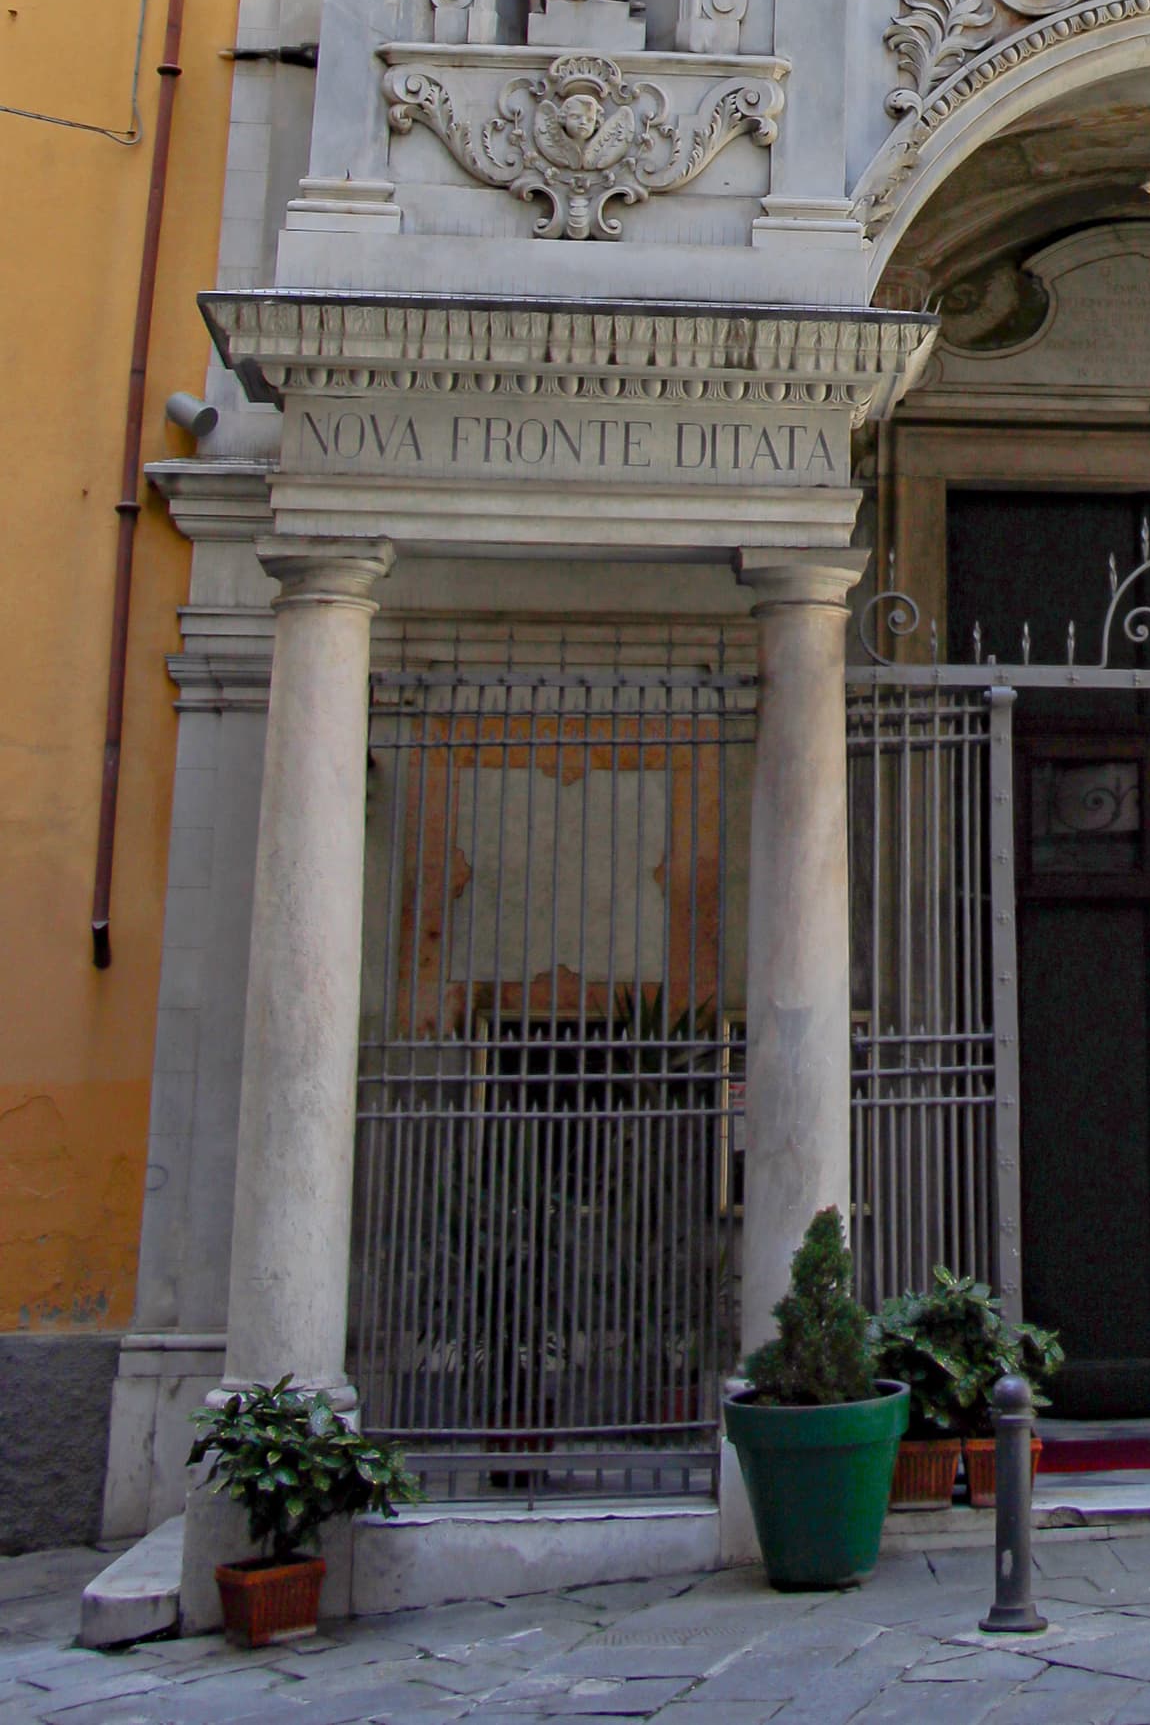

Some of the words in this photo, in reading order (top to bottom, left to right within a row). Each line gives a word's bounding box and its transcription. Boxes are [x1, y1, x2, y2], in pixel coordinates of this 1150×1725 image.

[303, 411, 424, 461] NOVA
[451, 416, 652, 467] FRONTE
[676, 421, 835, 472] DITATA
